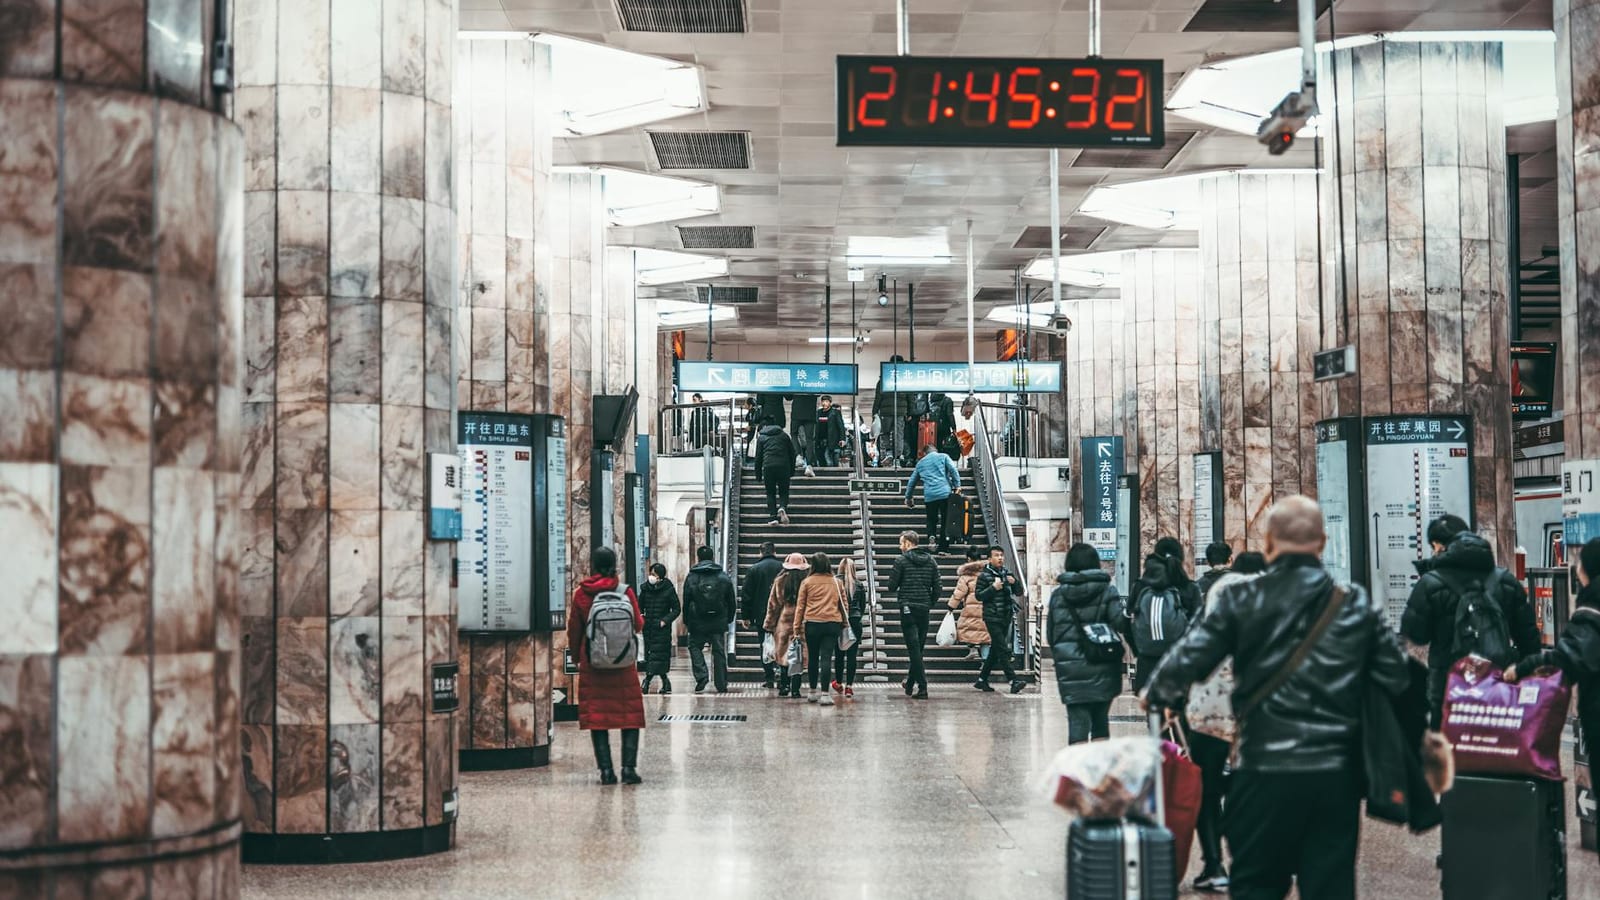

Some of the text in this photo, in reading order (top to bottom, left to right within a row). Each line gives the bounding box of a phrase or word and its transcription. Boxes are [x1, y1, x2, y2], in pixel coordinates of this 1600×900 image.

[857, 66, 1145, 131] 21:45:32
[796, 369, 830, 380] 换乘
[932, 370, 945, 384] B
[464, 422, 529, 437] 开往四惠东
[1371, 420, 1441, 435] 开往苹果园
[1386, 433, 1435, 441] PINGGUOYUAN
[1099, 460, 1113, 522] 去往2号线
